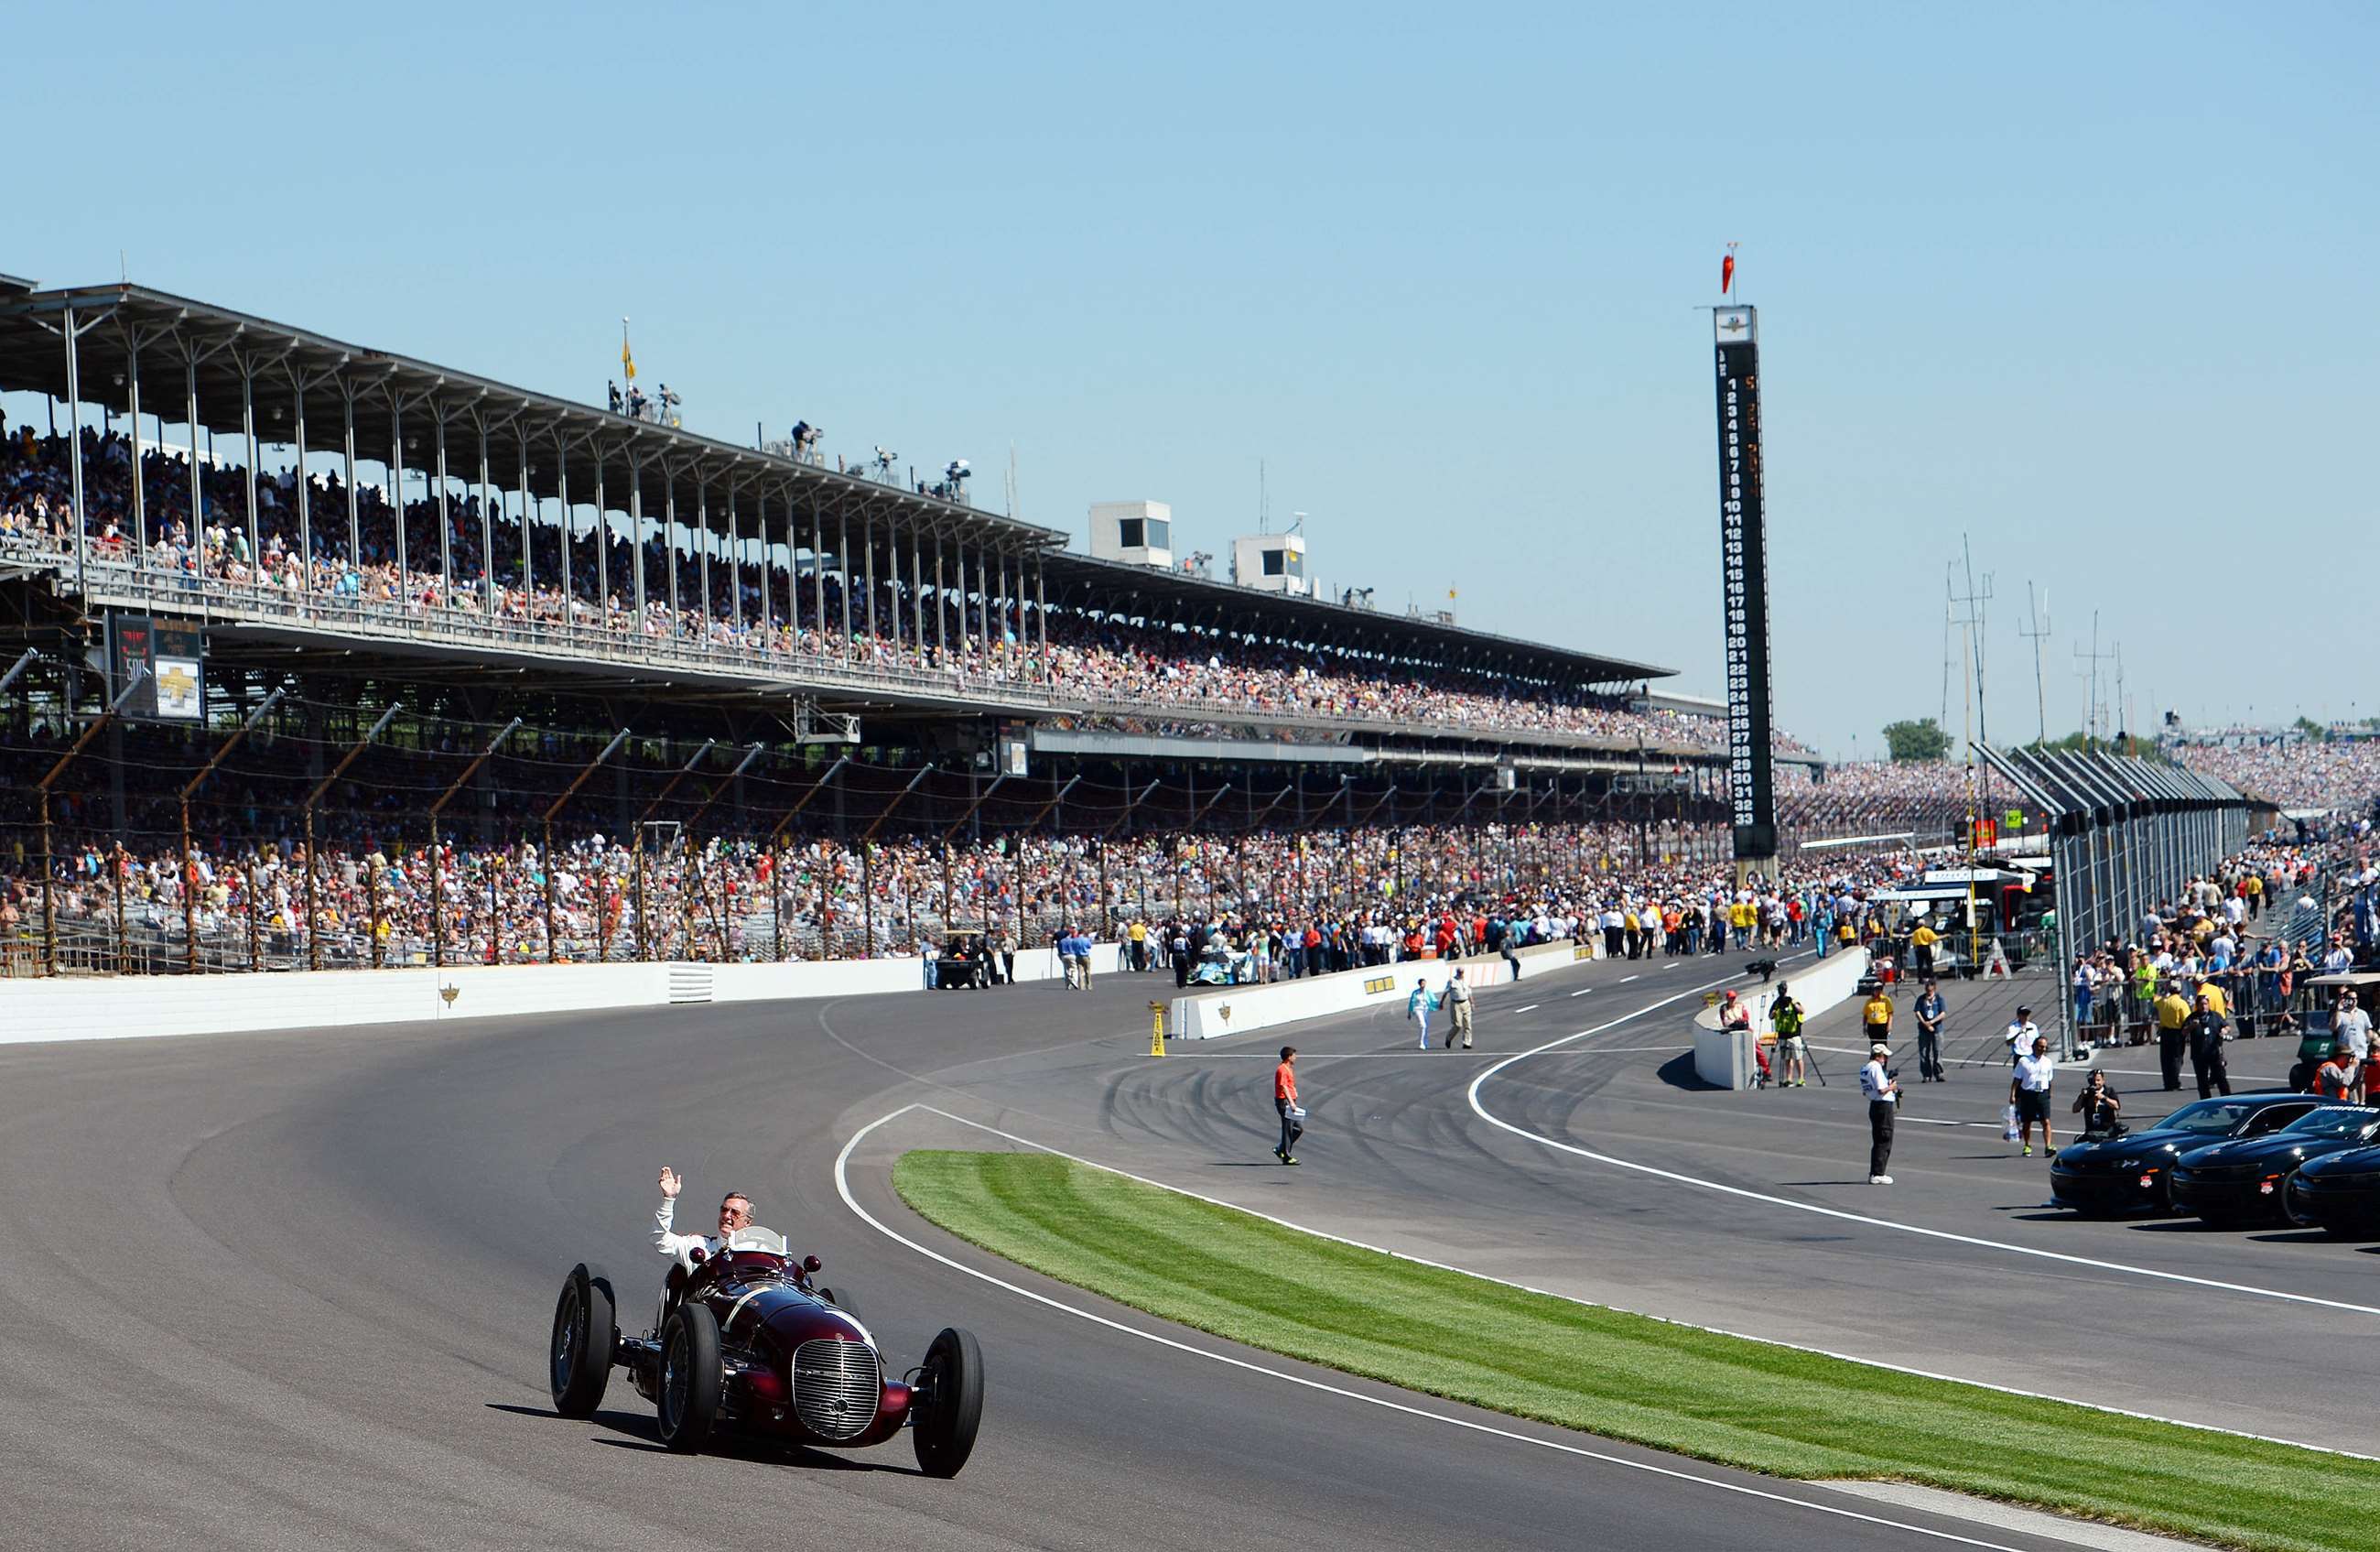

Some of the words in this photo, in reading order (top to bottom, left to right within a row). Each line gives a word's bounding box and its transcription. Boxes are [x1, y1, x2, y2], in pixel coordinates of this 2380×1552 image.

[1727, 379, 1736, 389] 1
[1726, 392, 1736, 403] 2
[1727, 406, 1737, 417] 3
[1727, 419, 1738, 430] 4
[1728, 433, 1738, 444] 5
[1728, 446, 1739, 458] 6
[1730, 461, 1739, 472] 7
[1730, 473, 1740, 485] 8
[1730, 487, 1741, 498] 9
[1724, 501, 1741, 512] 10
[1726, 515, 1742, 526] 11
[1726, 528, 1742, 539] 12
[1726, 542, 1743, 553] 13
[1726, 556, 1743, 566] 14
[1727, 569, 1744, 581] 15
[1727, 582, 1745, 593] 16
[1728, 596, 1745, 607] 17
[1728, 610, 1746, 621] 18
[1729, 624, 1747, 635] 19
[1728, 636, 1747, 648] 20
[1728, 650, 1747, 662] 21
[1730, 664, 1747, 675] 22
[1730, 678, 1748, 689] 23
[1730, 691, 1748, 702] 24
[1731, 705, 1749, 716] 25
[1732, 718, 1750, 730] 26
[1733, 732, 1750, 743] 27
[1733, 745, 1751, 757] 28
[1733, 759, 1751, 770] 29
[1733, 773, 1752, 784] 30
[1735, 787, 1753, 798] 31
[1735, 799, 1753, 811] 32
[1736, 813, 1754, 825] 33
